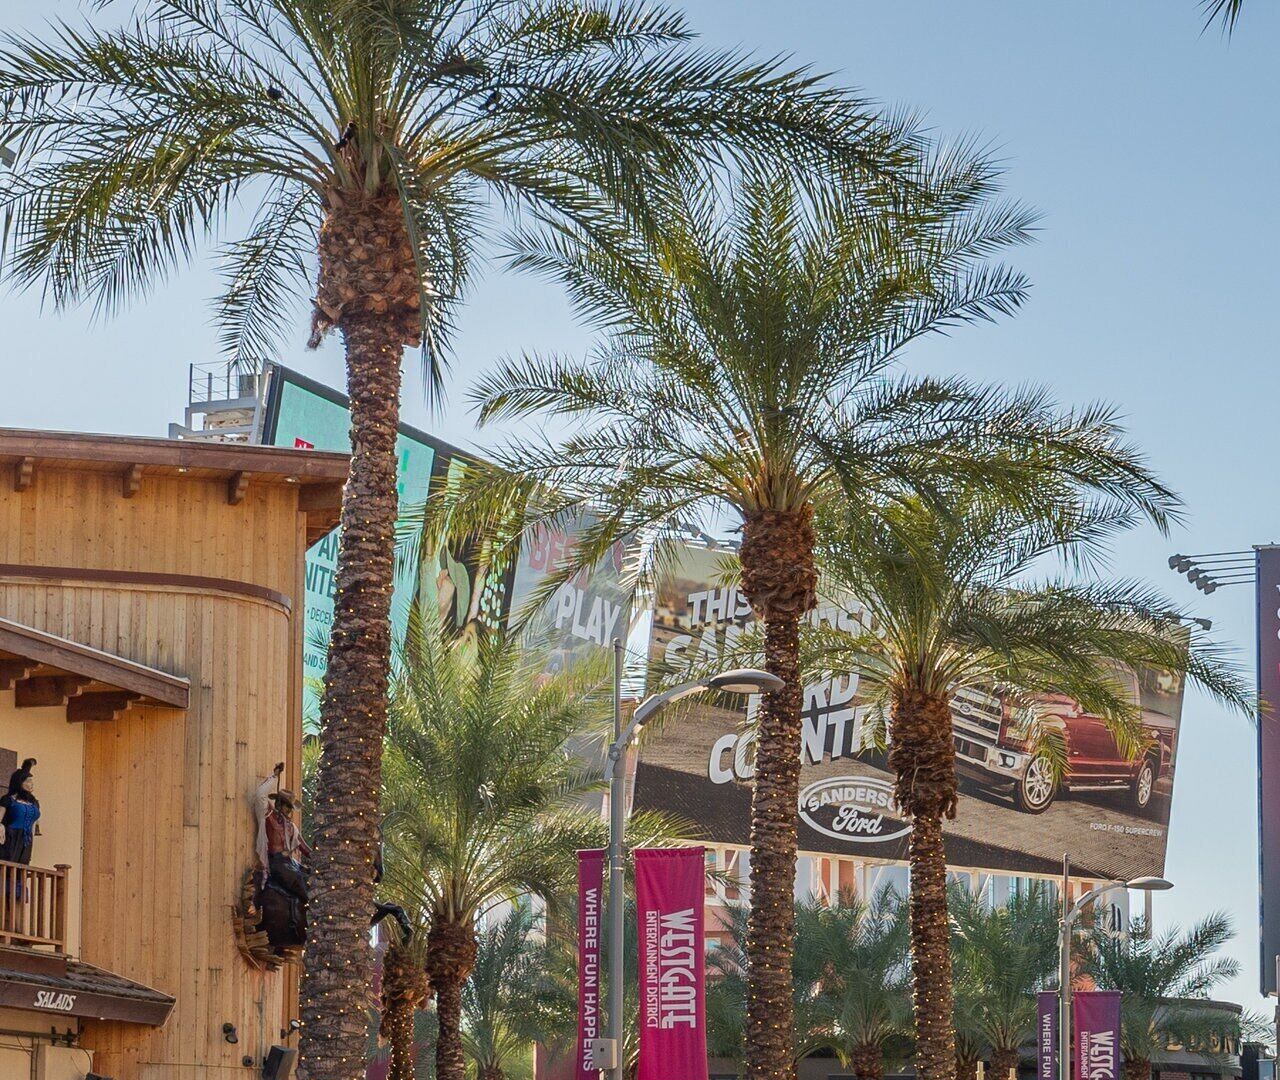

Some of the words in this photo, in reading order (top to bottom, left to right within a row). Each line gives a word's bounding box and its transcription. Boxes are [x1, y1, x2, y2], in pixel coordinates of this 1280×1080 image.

[555, 581, 620, 648] PLAY
[688, 585, 752, 627] THIS
[832, 803, 883, 835] Ford
[584, 887, 597, 949] WHERE
[645, 910, 658, 985] ENTERTAINMENT
[660, 908, 698, 1029] WESTGATE
[583, 953, 597, 987] FUN
[34, 990, 76, 1010] SALADS
[646, 987, 658, 1029] DISTRICT
[583, 993, 597, 1072] HAPPENS
[1042, 1013, 1051, 1053] WHERE
[1042, 1057, 1051, 1077] FUN
[1080, 1031, 1089, 1080] ENTERTAINMENT
